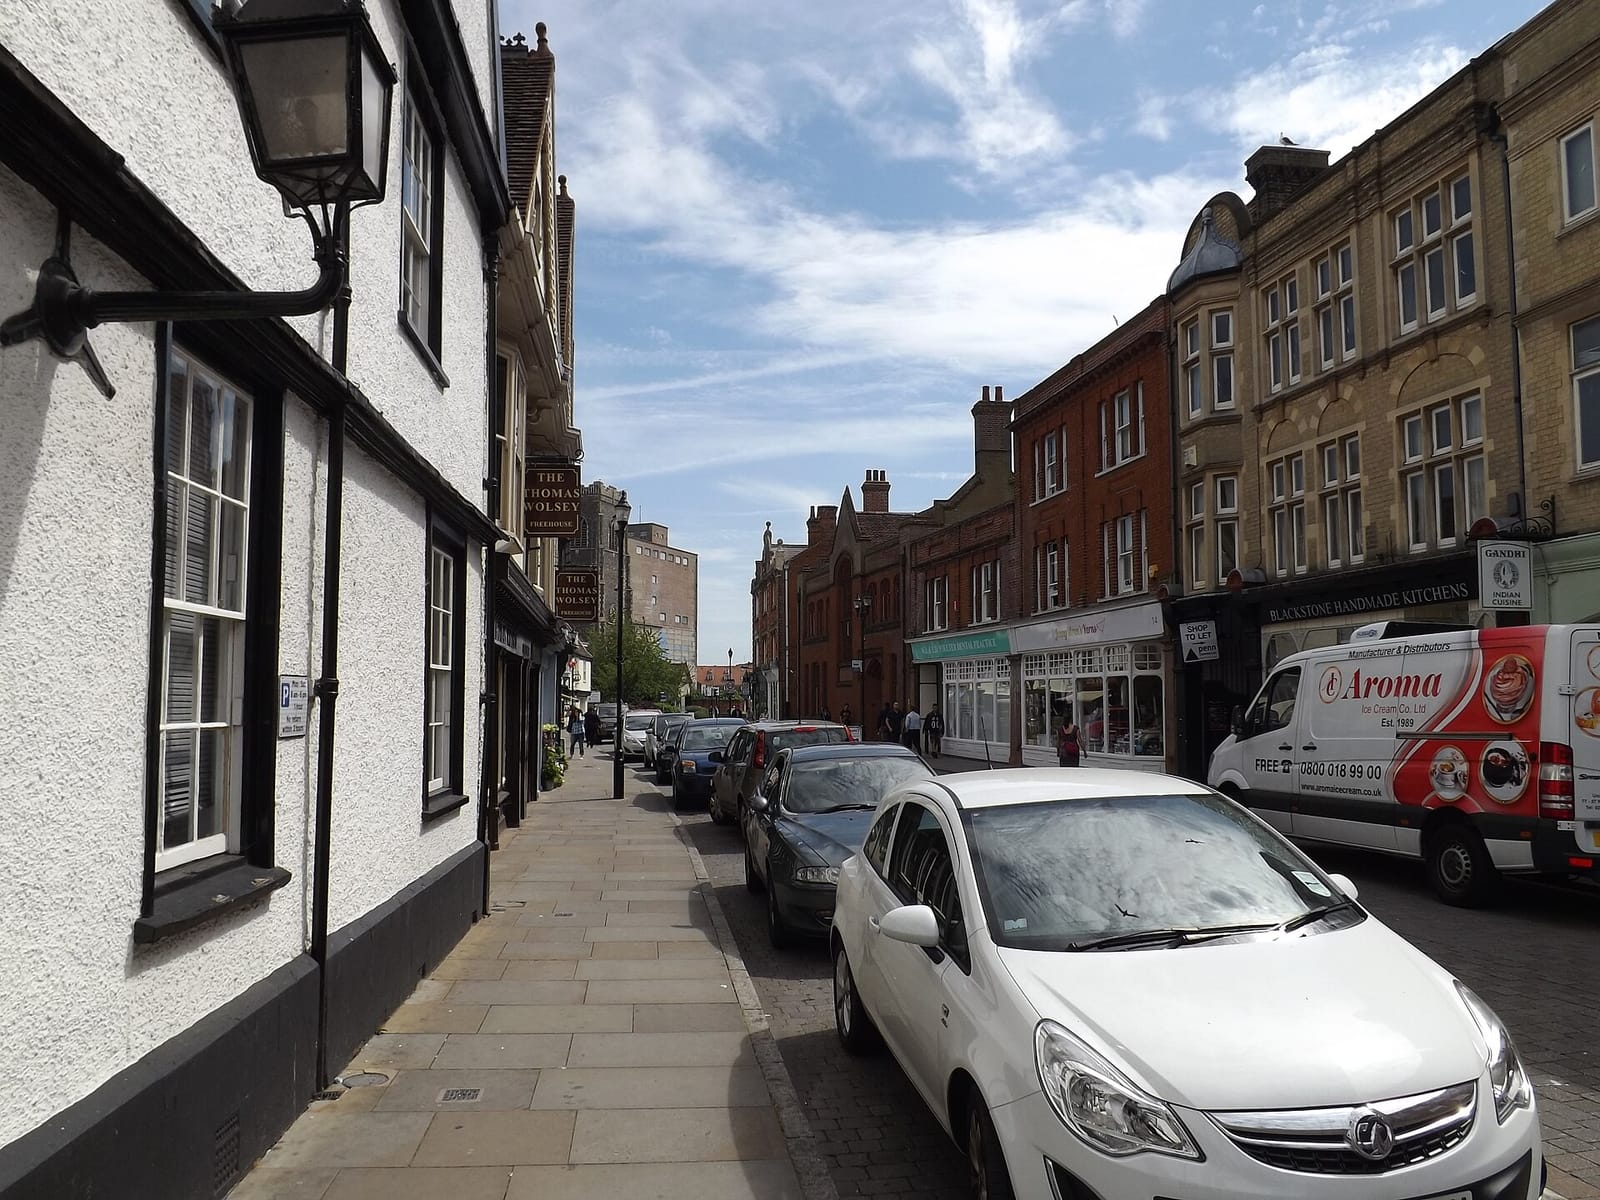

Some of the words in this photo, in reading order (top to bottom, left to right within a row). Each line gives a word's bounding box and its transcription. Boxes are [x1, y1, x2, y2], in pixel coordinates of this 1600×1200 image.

[537, 472, 565, 483] THE
[524, 488, 580, 498] THOMAS
[524, 502, 580, 512] WOLSEY
[530, 520, 573, 528] FREEHOUSE
[1485, 549, 1526, 558] GANDHI
[566, 575, 586, 583] THE
[556, 587, 598, 595] THOMAS
[556, 596, 598, 604] WOLSEY
[1269, 601, 1331, 622] BLACKSTONE
[1334, 592, 1400, 614] HANDMADE
[1403, 582, 1469, 604] KITCHENS
[1187, 624, 1208, 633] SHOP
[1185, 633, 1196, 641] TO
[1198, 631, 1212, 640] LET
[1198, 645, 1217, 653] penn
[1348, 647, 1396, 658] Manufacturer
[1396, 645, 1402, 654] &
[1403, 641, 1451, 654] Distributors
[1341, 667, 1442, 700] Aroma
[1361, 704, 1371, 714] Ice
[1373, 704, 1396, 714] Cream
[1399, 703, 1411, 713] Co.
[1414, 704, 1426, 714] Ltd
[1381, 718, 1394, 727] Est.
[1397, 718, 1414, 727] 1989
[1255, 758, 1279, 773] FREE
[1300, 761, 1325, 775] 0800
[1328, 763, 1347, 778] 018
[1349, 763, 1364, 779] 99
[1366, 765, 1382, 780] 00
[1300, 783, 1383, 797] www.aromaicecream.co.uk
